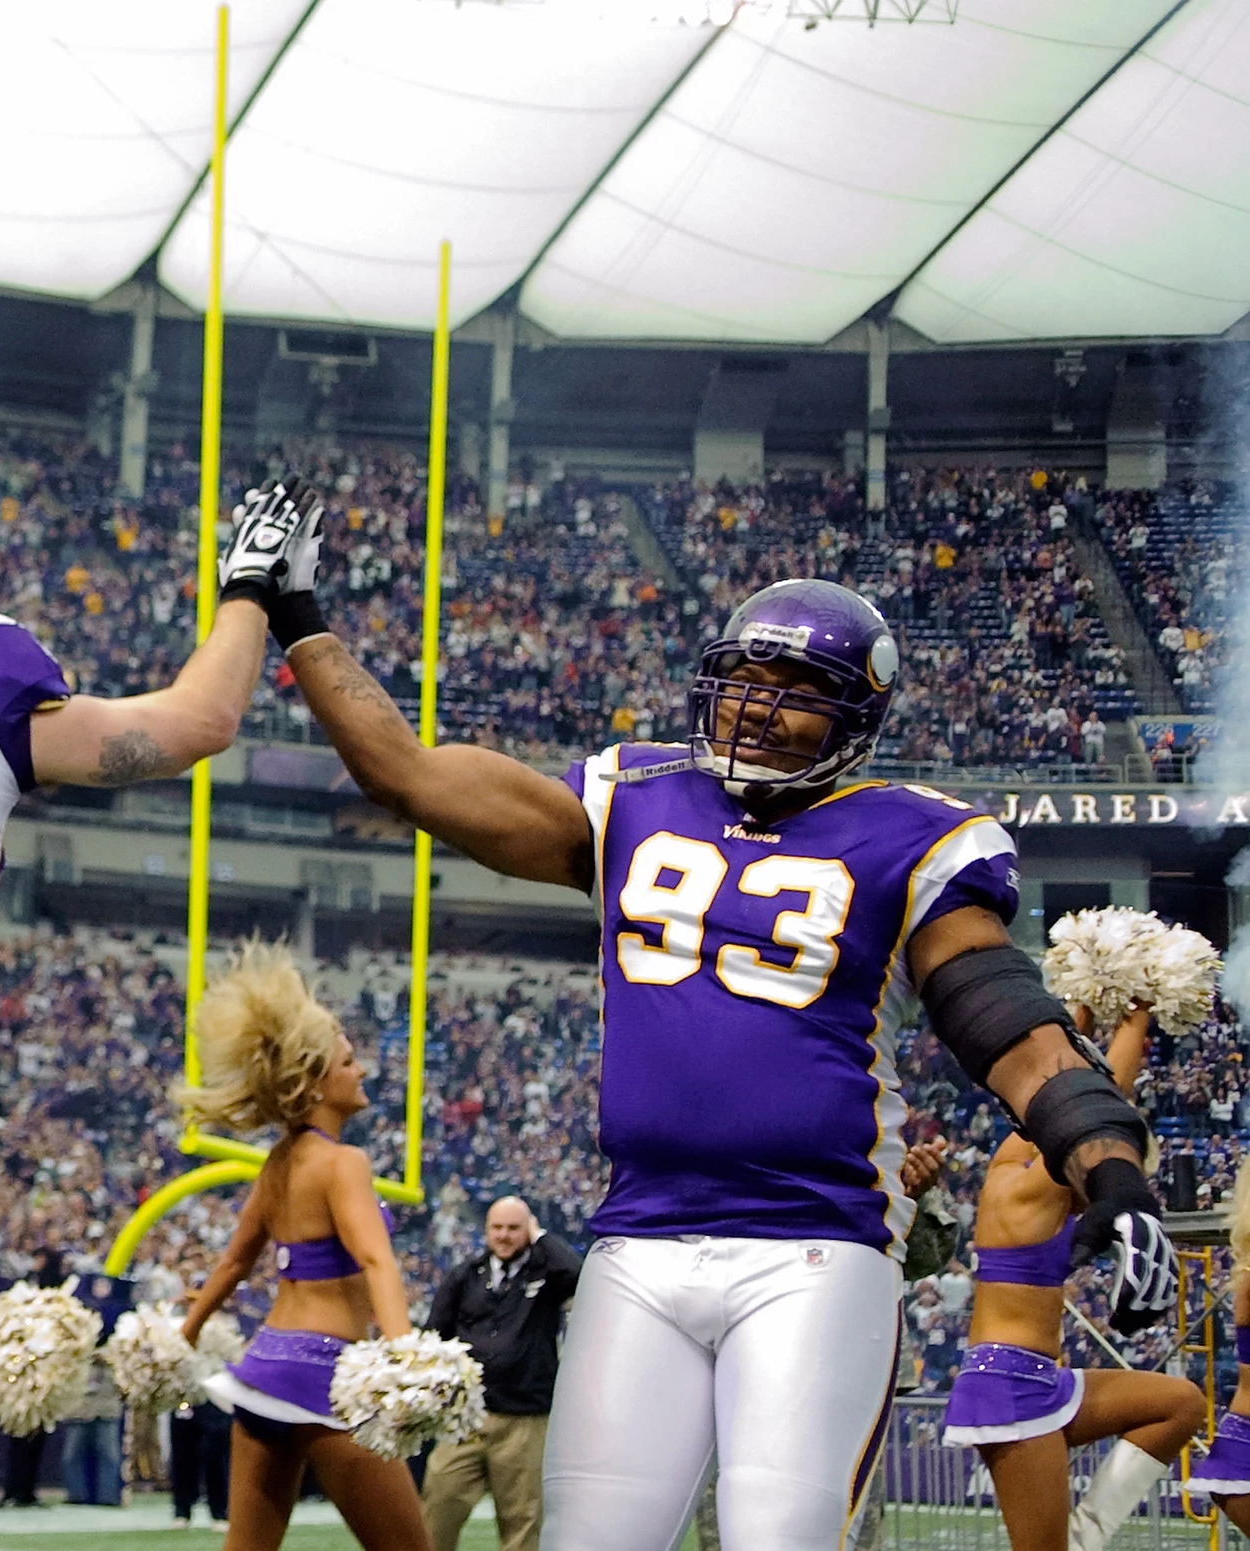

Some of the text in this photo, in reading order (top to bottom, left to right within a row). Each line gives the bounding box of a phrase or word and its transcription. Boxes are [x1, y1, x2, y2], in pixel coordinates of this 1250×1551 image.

[645, 762, 685, 776] Riddell
[999, 794, 1179, 824] JARED
[616, 830, 856, 1010] 93
